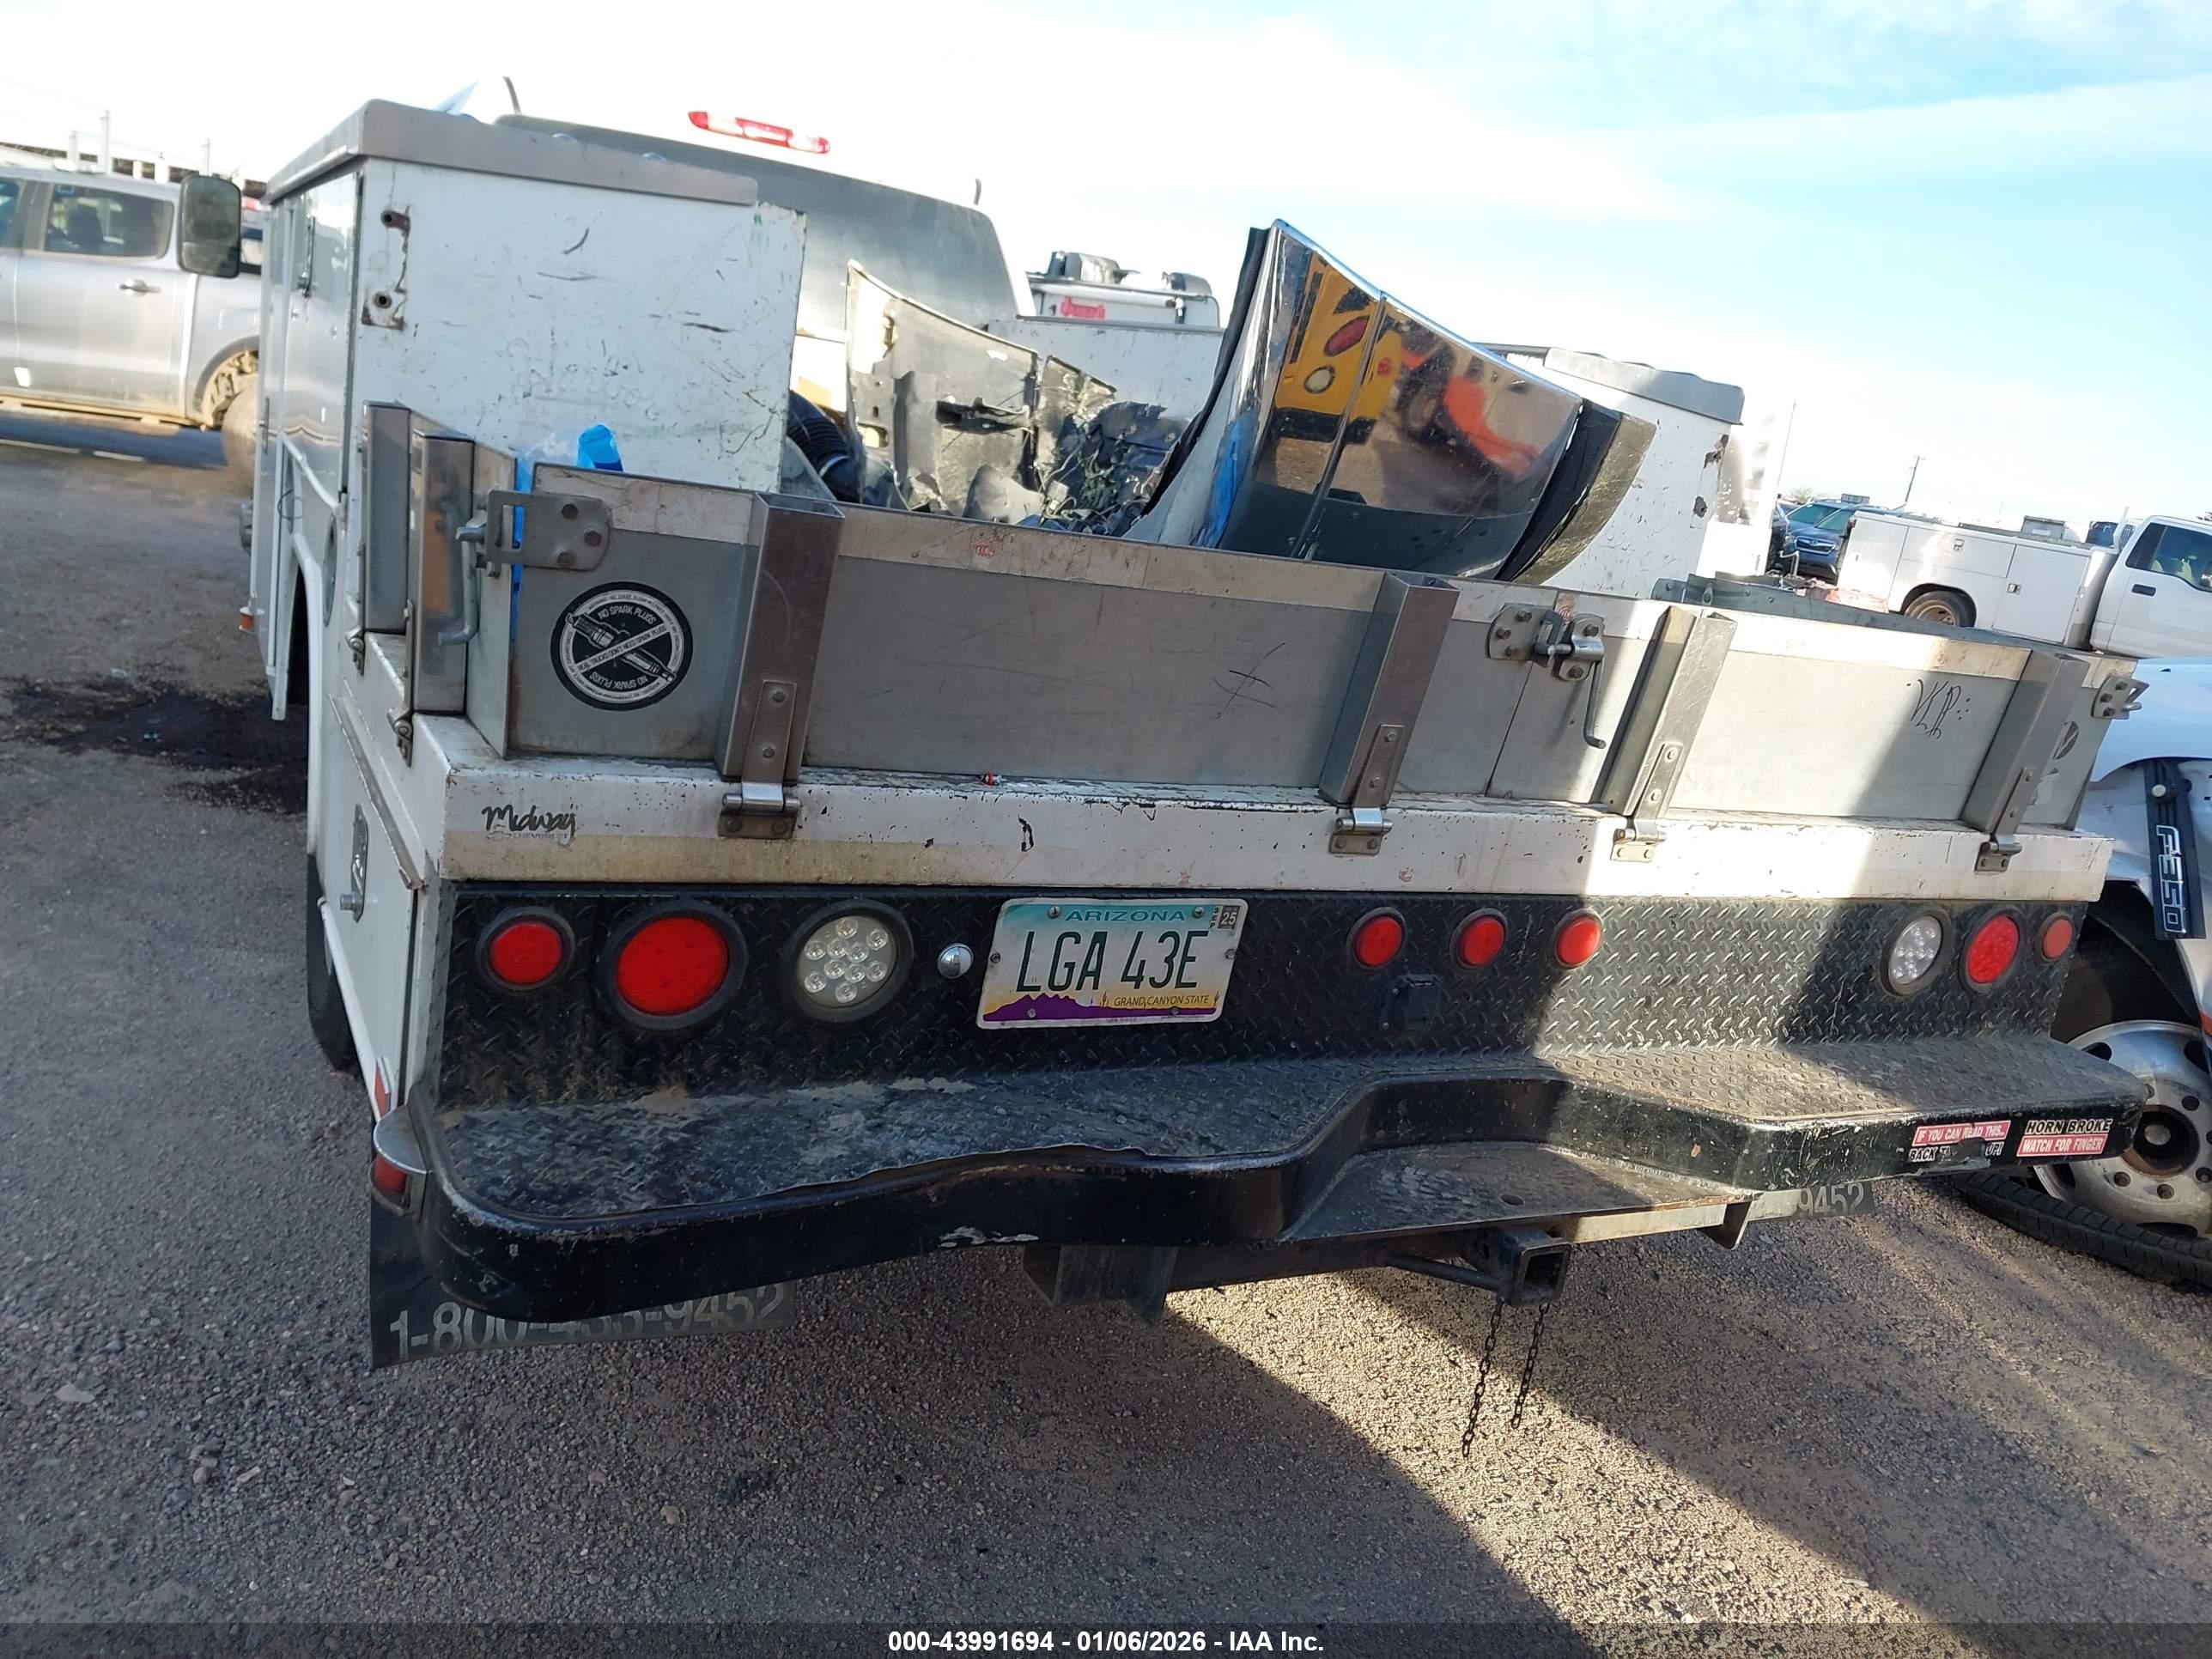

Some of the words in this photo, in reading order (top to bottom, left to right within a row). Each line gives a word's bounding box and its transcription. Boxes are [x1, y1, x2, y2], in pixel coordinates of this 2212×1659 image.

[598, 609, 609, 619] NO
[610, 605, 633, 615] SPARK
[634, 606, 657, 625] PLUGS
[589, 671, 611, 689] PLUGS
[613, 678, 637, 690] SPARK
[638, 674, 648, 685] NO
[481, 804, 577, 845] Midway
[1064, 909, 1186, 922] ARIZONA
[1210, 907, 1220, 929] SEP
[1220, 911, 1237, 926] 25
[1016, 931, 1108, 993] LGA
[1120, 930, 1209, 989] 43E
[1114, 996, 1144, 1006] GRAND
[1146, 995, 1185, 1006] CANYON
[1185, 994, 1210, 1005] STATE
[1917, 1130, 1926, 1143] IF
[1928, 1127, 1944, 1141] YOU
[1944, 1127, 1962, 1140] CAN
[1964, 1126, 1983, 1139] READ
[2024, 1119, 2064, 1135] HORN
[2067, 1118, 2113, 1133] BROKE
[2021, 1138, 2052, 1152] WATCH
[2054, 1137, 2072, 1152] FOR
[2073, 1136, 2105, 1152] FINGER
[1909, 1146, 1938, 1163] BACK
